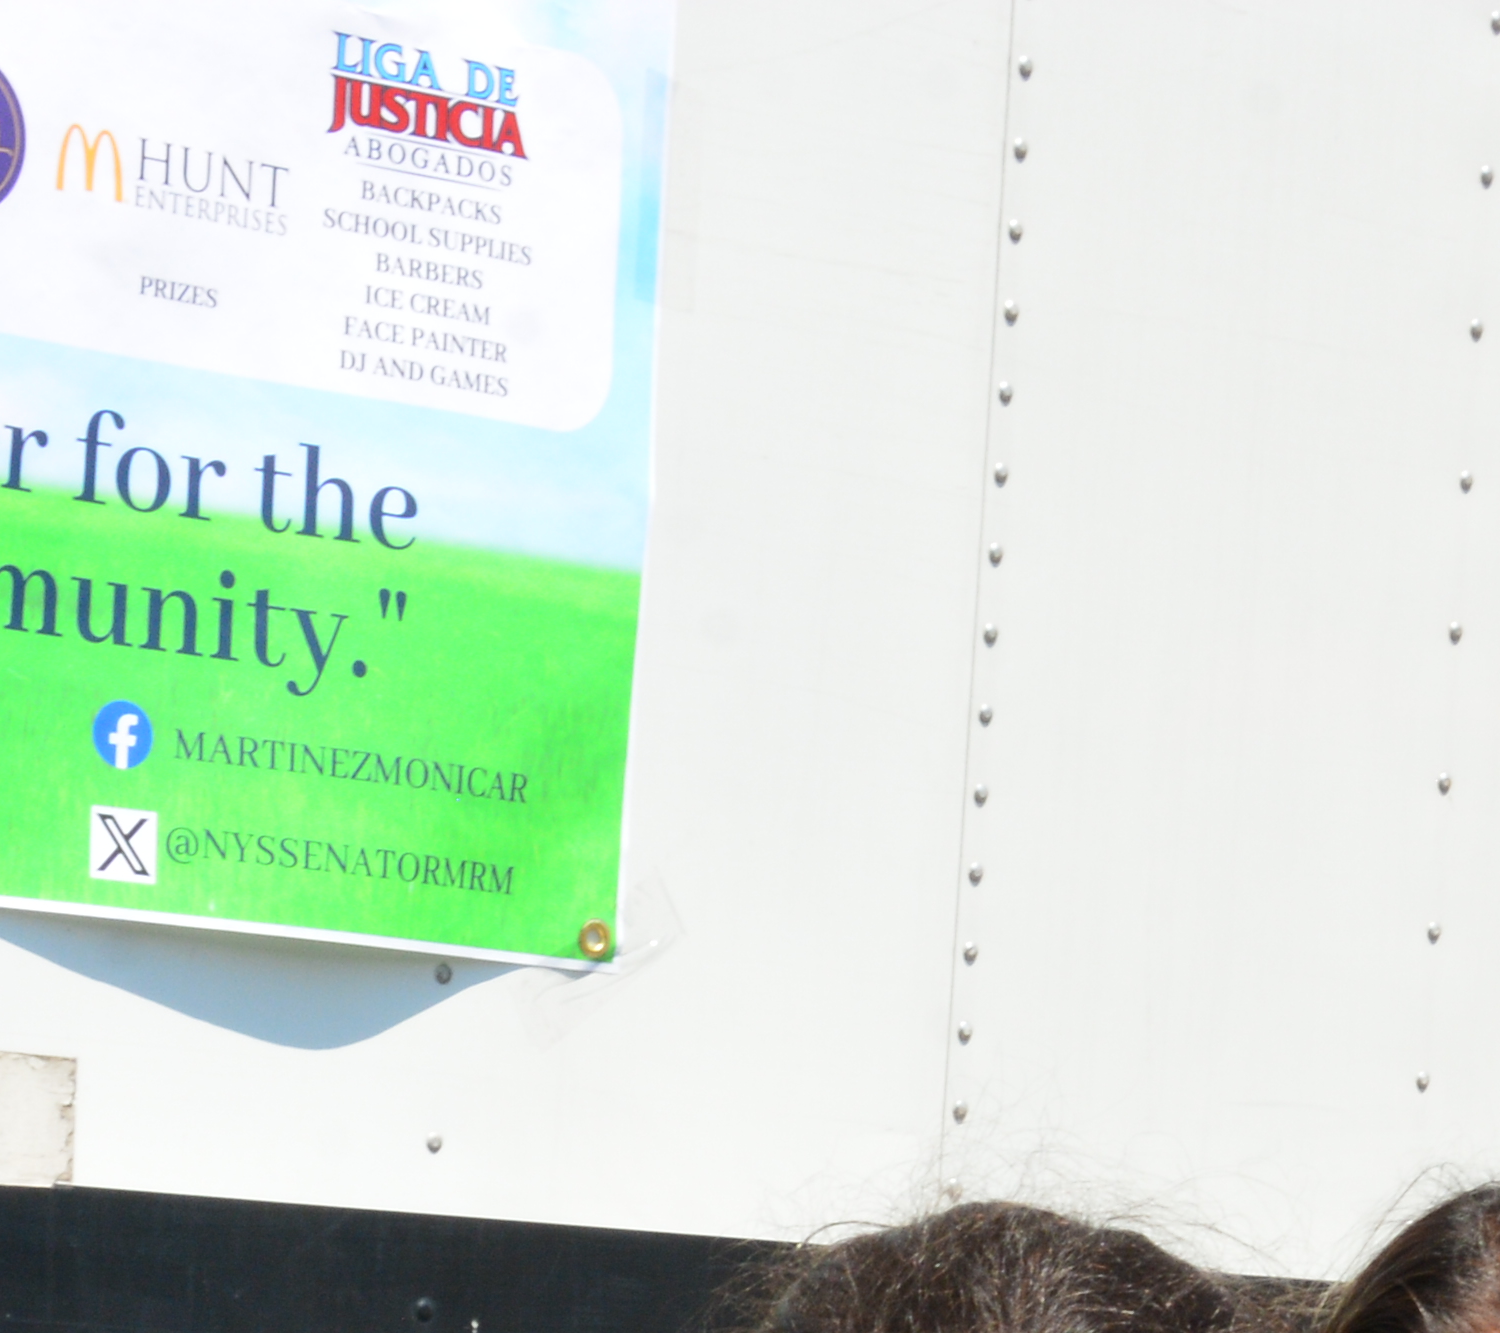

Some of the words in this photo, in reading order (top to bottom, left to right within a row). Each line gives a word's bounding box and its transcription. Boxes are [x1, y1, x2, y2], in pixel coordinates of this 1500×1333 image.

[331, 30, 442, 91] LIGA
[462, 57, 520, 108] DE
[326, 72, 530, 161] JUSTICIA
[136, 136, 291, 209] HUNT
[343, 136, 514, 187] ABOGADOS
[134, 185, 290, 238] ENTERPRISES
[361, 180, 503, 225] BACKPACKS
[322, 208, 424, 246] SCHOOL
[428, 226, 532, 266] SUPPLIES
[139, 275, 219, 310] PRIZES
[375, 252, 484, 290] BARBERS
[365, 284, 404, 311] ICE
[409, 292, 491, 326] CREAM
[343, 315, 405, 345] FACE
[411, 326, 508, 363] PAINTER
[340, 349, 368, 374] DJ
[373, 356, 425, 382] AND
[430, 364, 510, 398] GAMES
[74, 408, 226, 520] for
[255, 442, 418, 551] the
[173, 725, 530, 806] MARTINEZMONICAR
[164, 825, 515, 898] @NYSSENATORMRM
